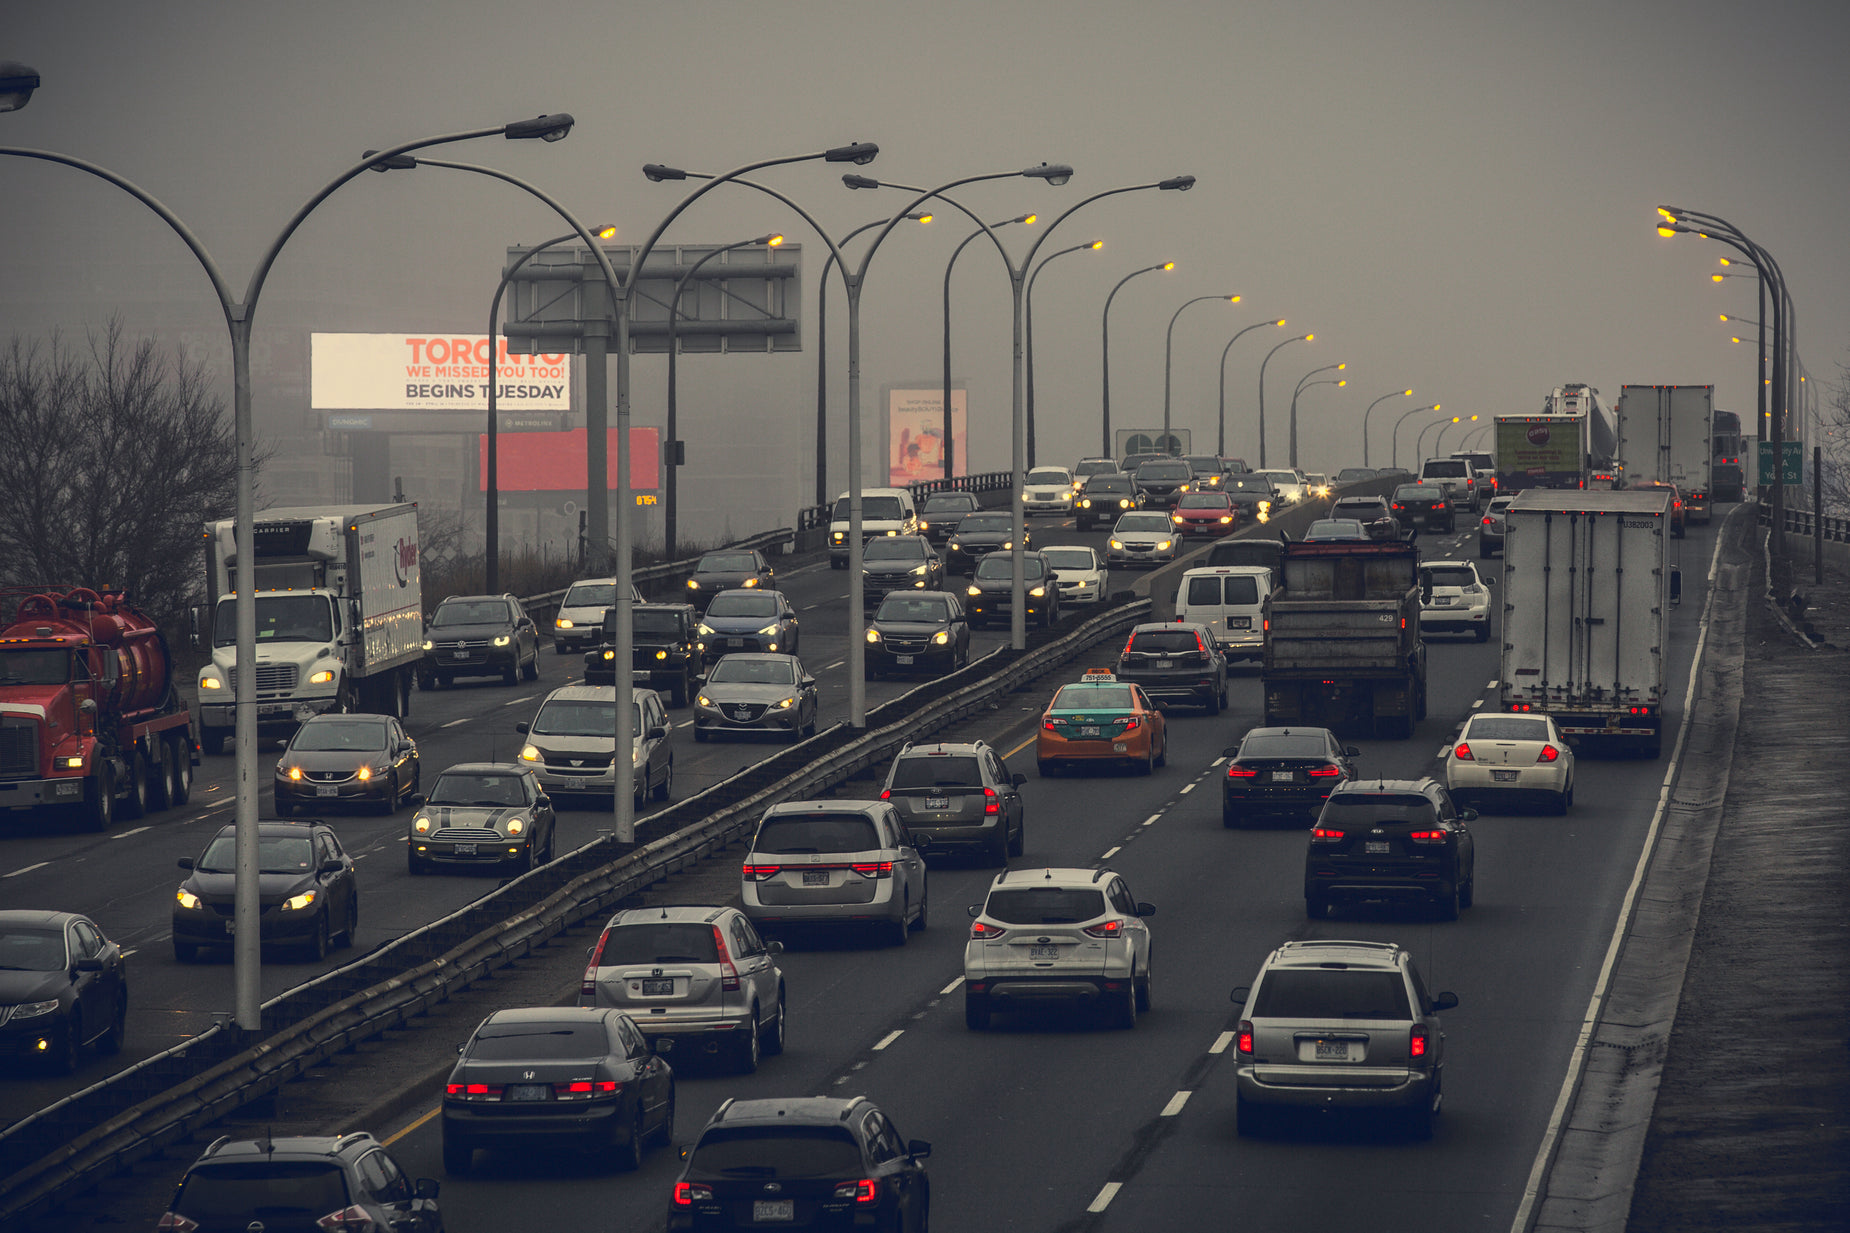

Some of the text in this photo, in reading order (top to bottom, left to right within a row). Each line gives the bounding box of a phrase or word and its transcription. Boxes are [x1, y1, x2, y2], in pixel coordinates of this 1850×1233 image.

[406, 338, 565, 367] TORON,
[406, 366, 565, 379] WE MISSED YOU TOO!
[406, 384, 565, 399] BEGINS TUESDAY
[1760, 447, 1792, 457] Univity
[1765, 471, 1797, 480] Yo St
[1379, 614, 1394, 622] 429
